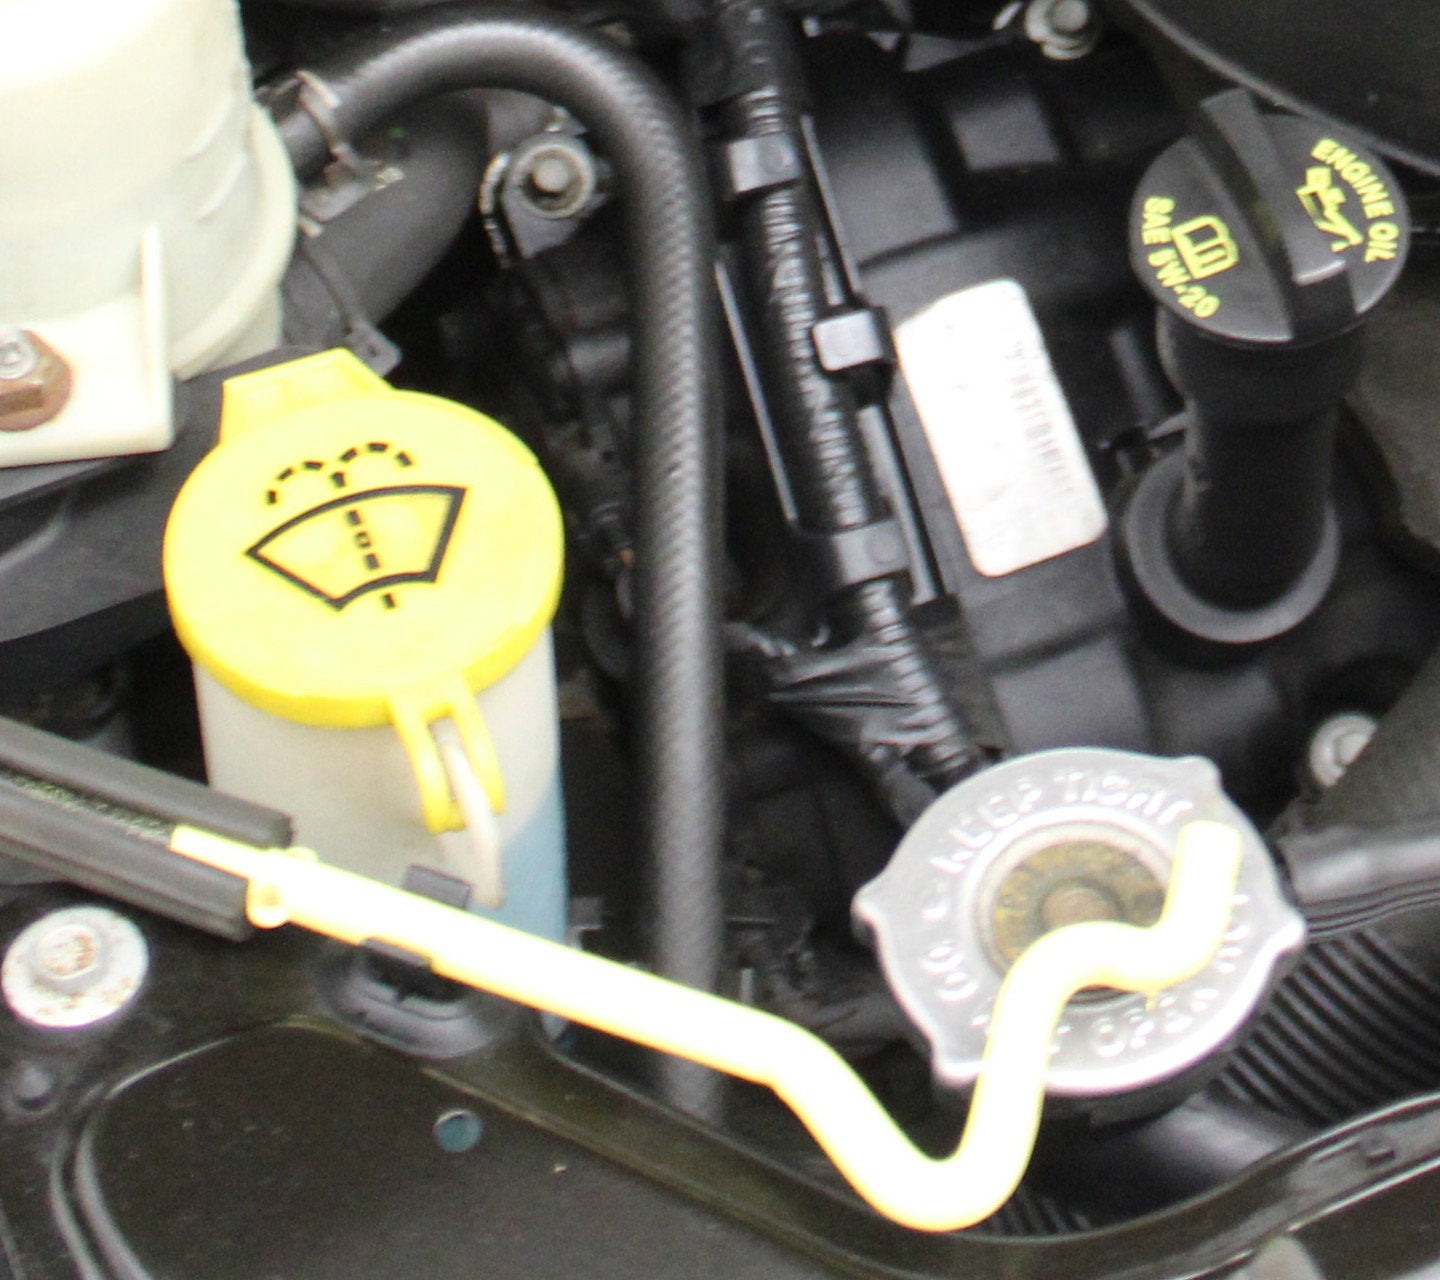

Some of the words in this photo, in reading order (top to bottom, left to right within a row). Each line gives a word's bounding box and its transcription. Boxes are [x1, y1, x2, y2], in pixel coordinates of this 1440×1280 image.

[1141, 196, 1176, 246] SAE
[1310, 137, 1396, 219] ENGINE
[1363, 220, 1400, 264] OIL
